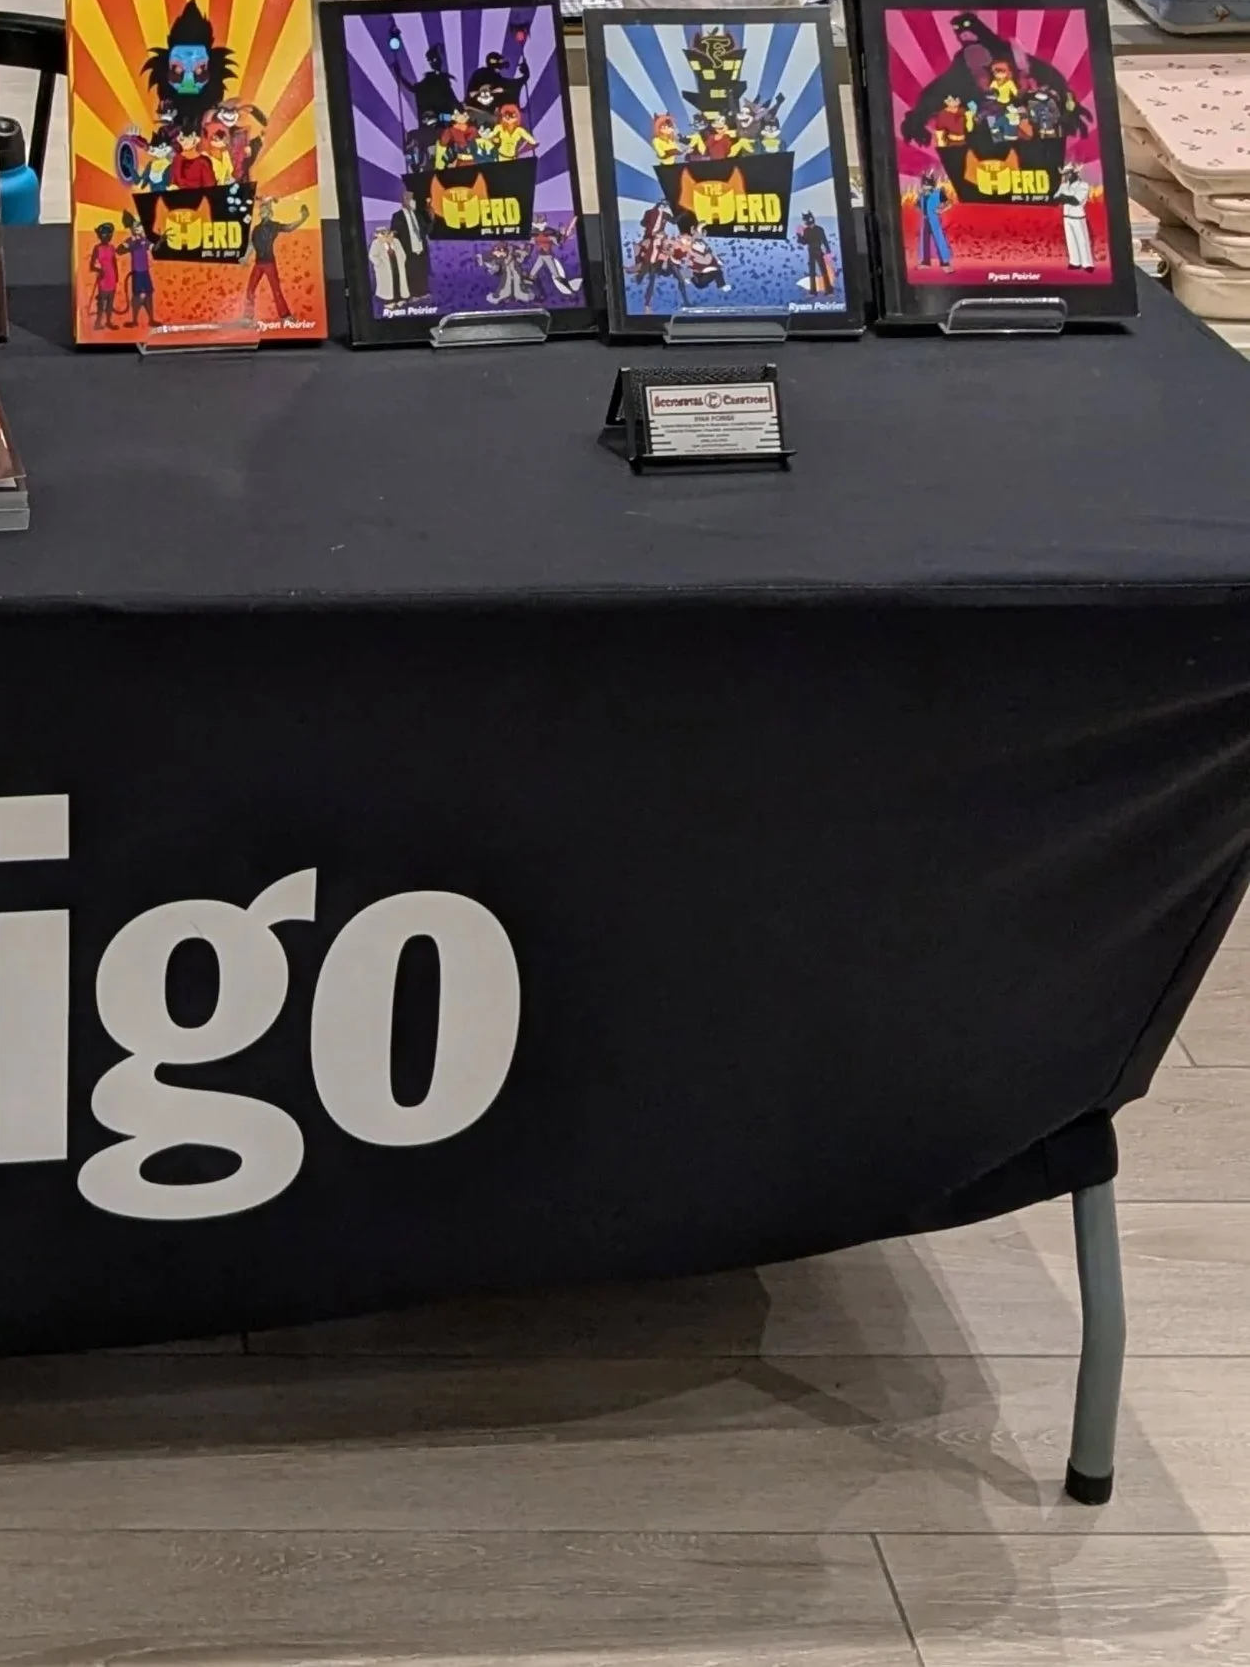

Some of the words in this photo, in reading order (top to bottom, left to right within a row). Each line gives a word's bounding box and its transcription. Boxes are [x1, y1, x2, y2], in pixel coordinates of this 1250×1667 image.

[976, 167, 1050, 196] HERD
[704, 184, 722, 195] THE
[442, 195, 521, 229] HERD
[693, 190, 782, 225] HERD
[165, 217, 243, 250] HERD
[988, 272, 1010, 282] Ryan
[383, 307, 406, 318] Ryan
[407, 306, 438, 316] Poirier
[789, 302, 812, 313] Ryan
[814, 302, 845, 311] Poirier
[283, 321, 316, 330] Poirier
